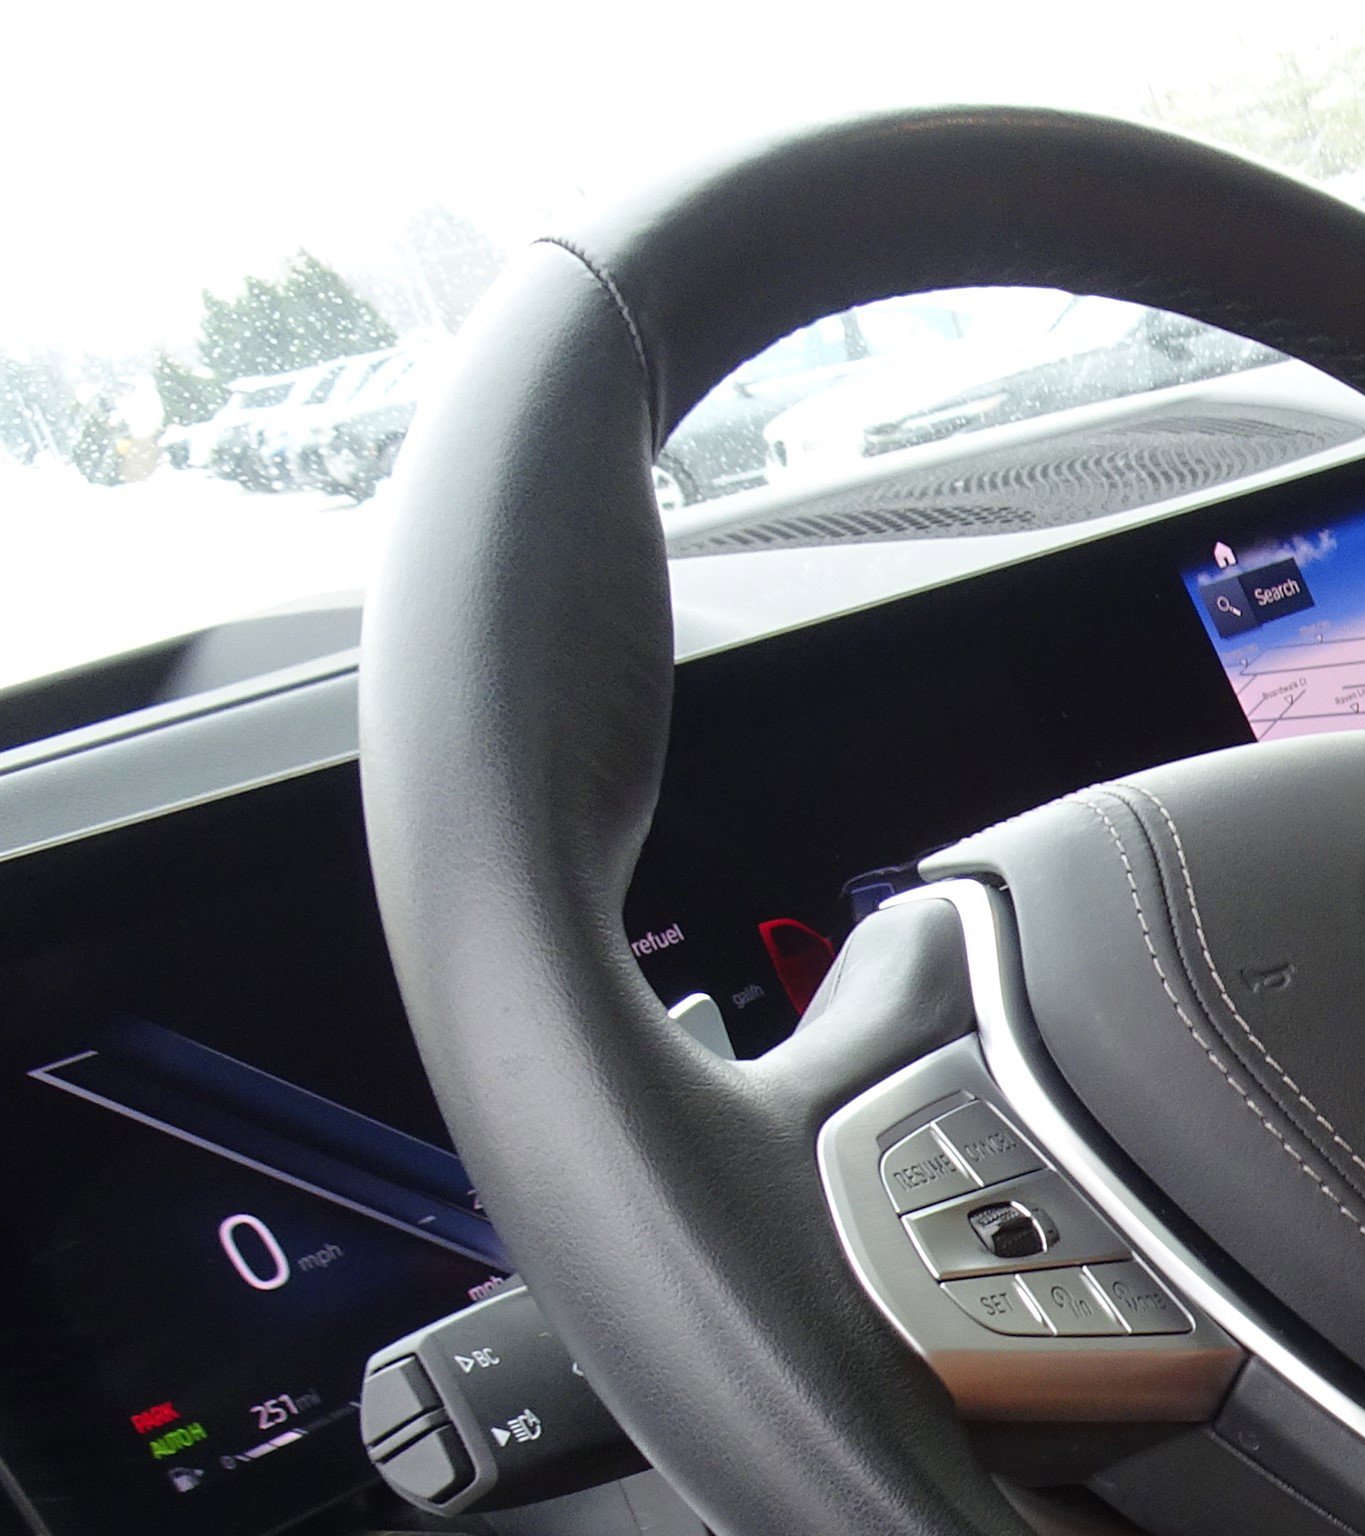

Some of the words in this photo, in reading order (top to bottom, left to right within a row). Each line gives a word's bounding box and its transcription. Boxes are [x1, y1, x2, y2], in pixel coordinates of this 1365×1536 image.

[1254, 577, 1300, 607] Search
[631, 922, 686, 957] refuel
[893, 1154, 957, 1191] RESUME
[219, 1214, 290, 1290] 0
[298, 1242, 344, 1272] mph
[979, 1291, 1013, 1317] SET
[471, 1347, 500, 1368] BC
[249, 1393, 299, 1429] 251
